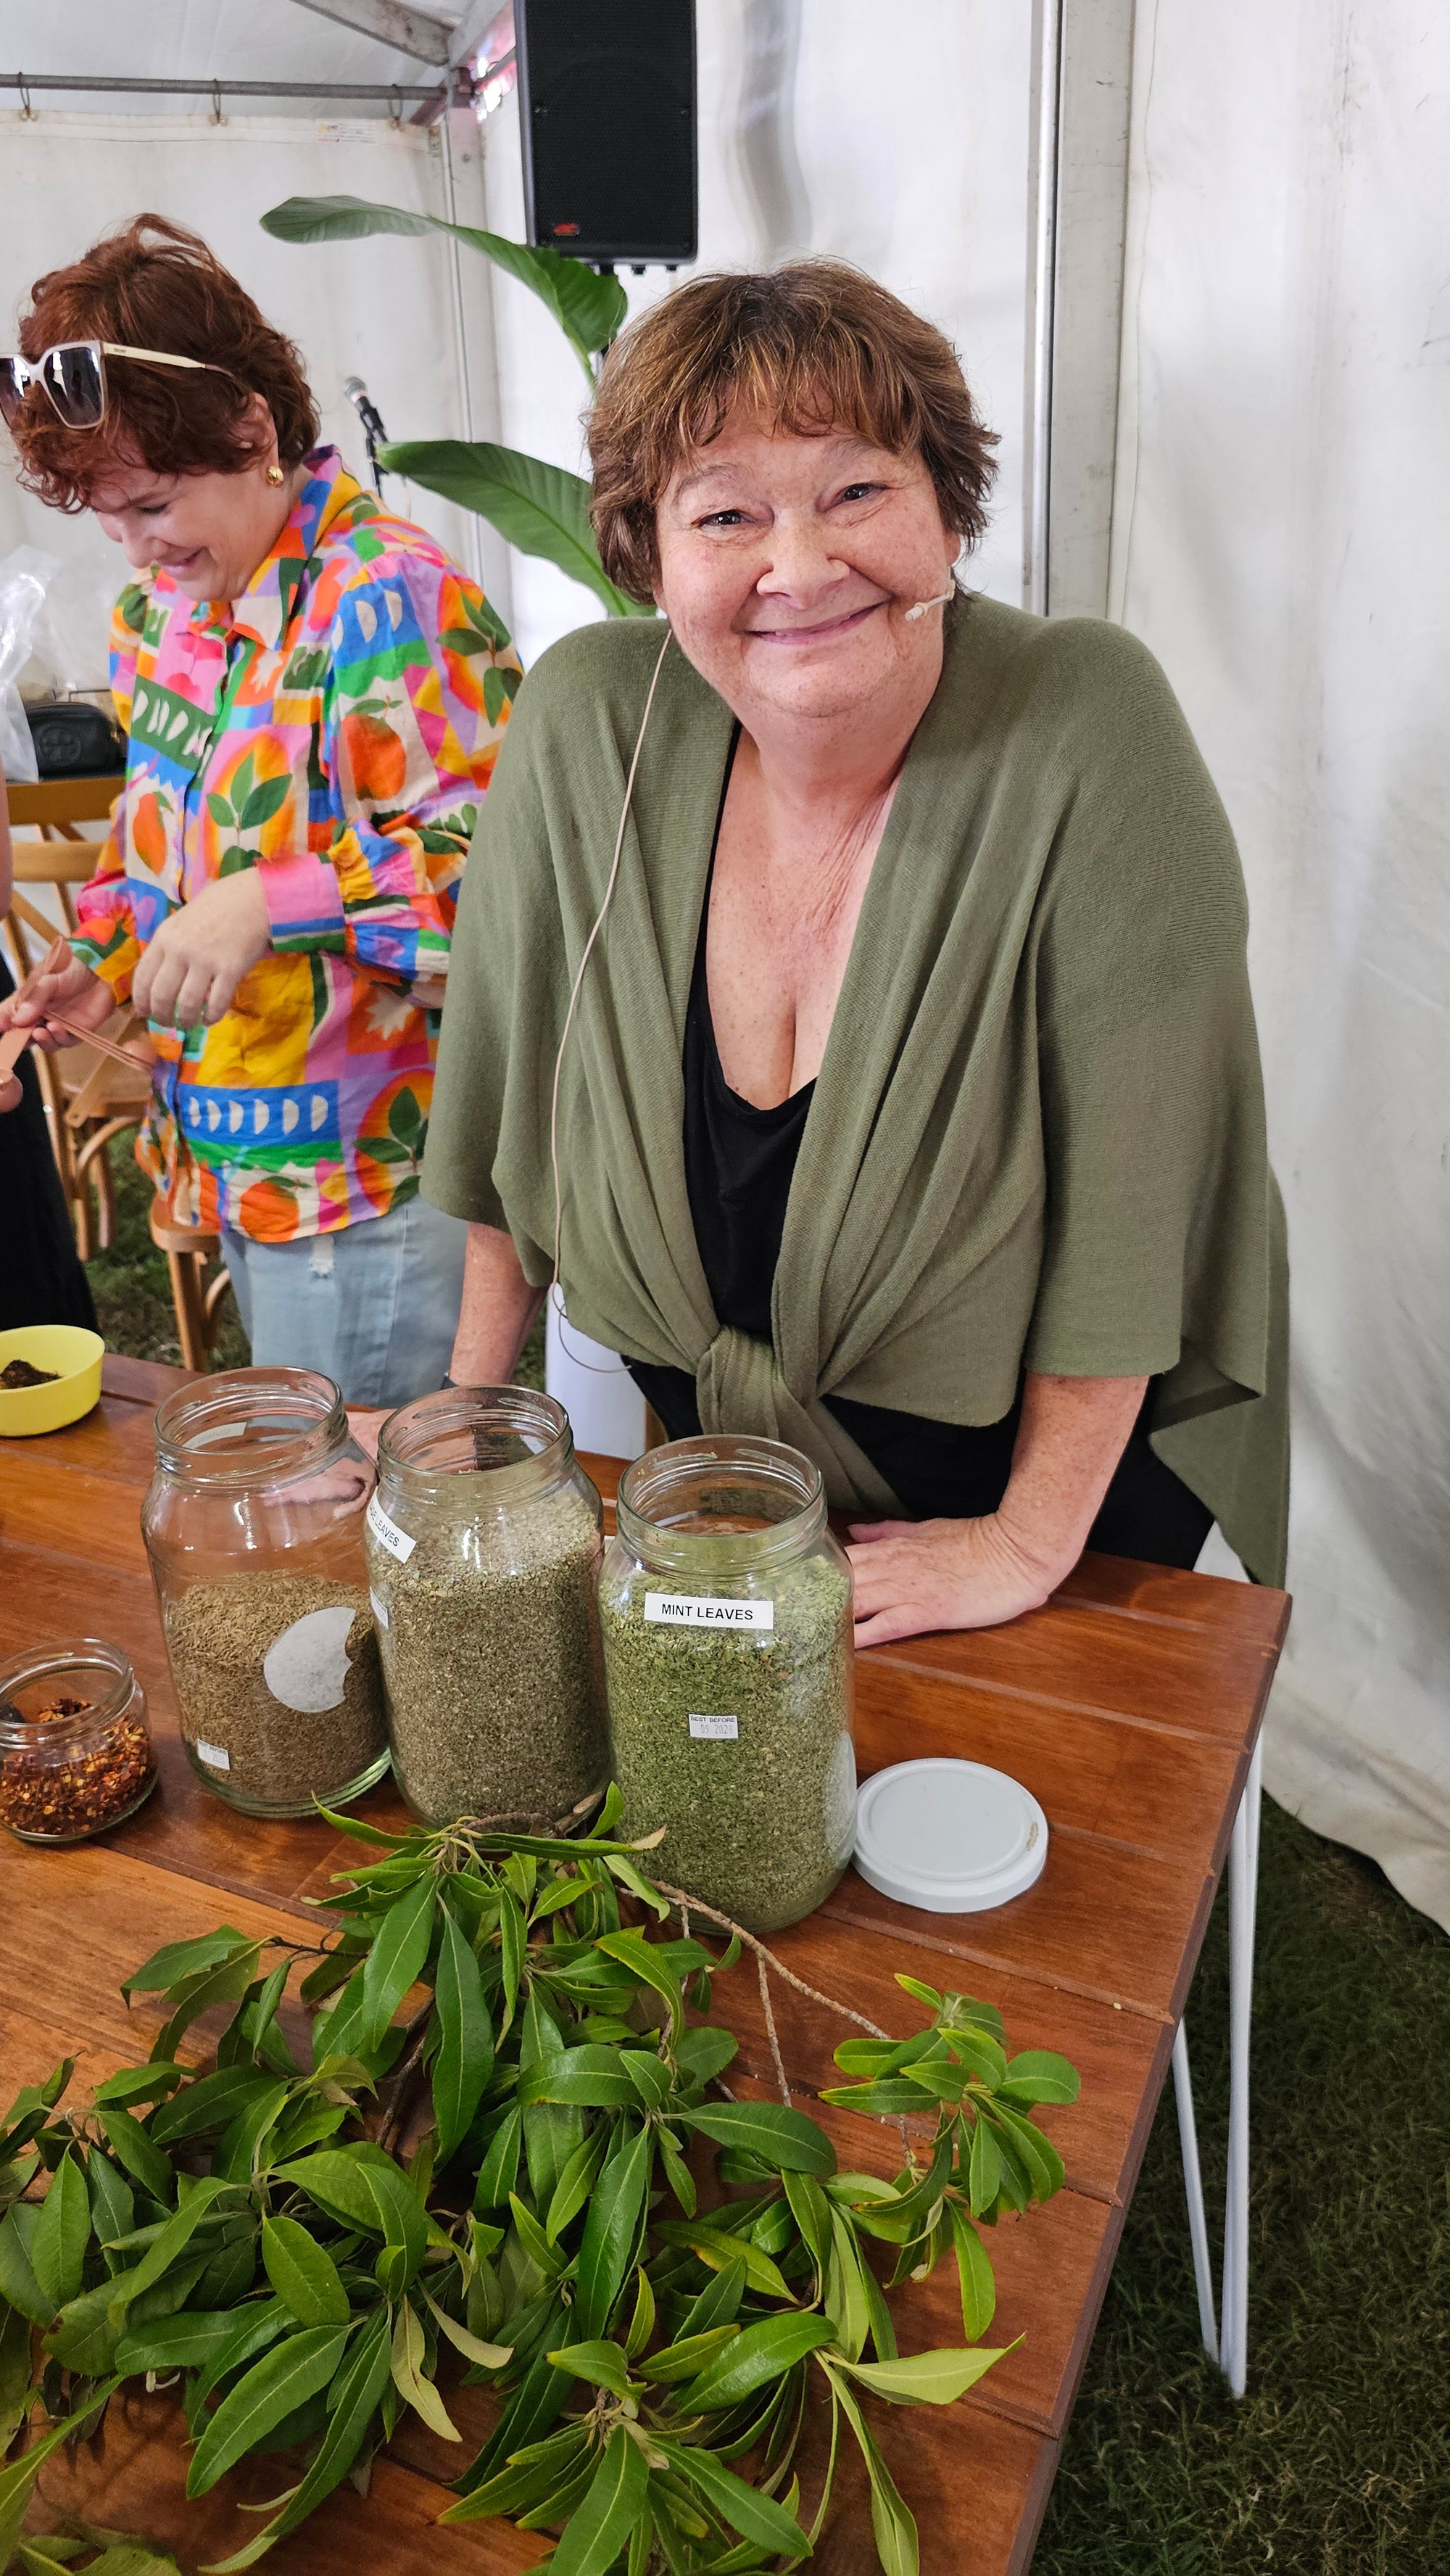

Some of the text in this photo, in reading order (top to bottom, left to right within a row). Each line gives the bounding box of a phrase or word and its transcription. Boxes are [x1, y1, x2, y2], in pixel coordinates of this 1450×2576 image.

[375, 1517, 399, 1546] LEAVES
[662, 1603, 753, 1620] MINT LEAVES
